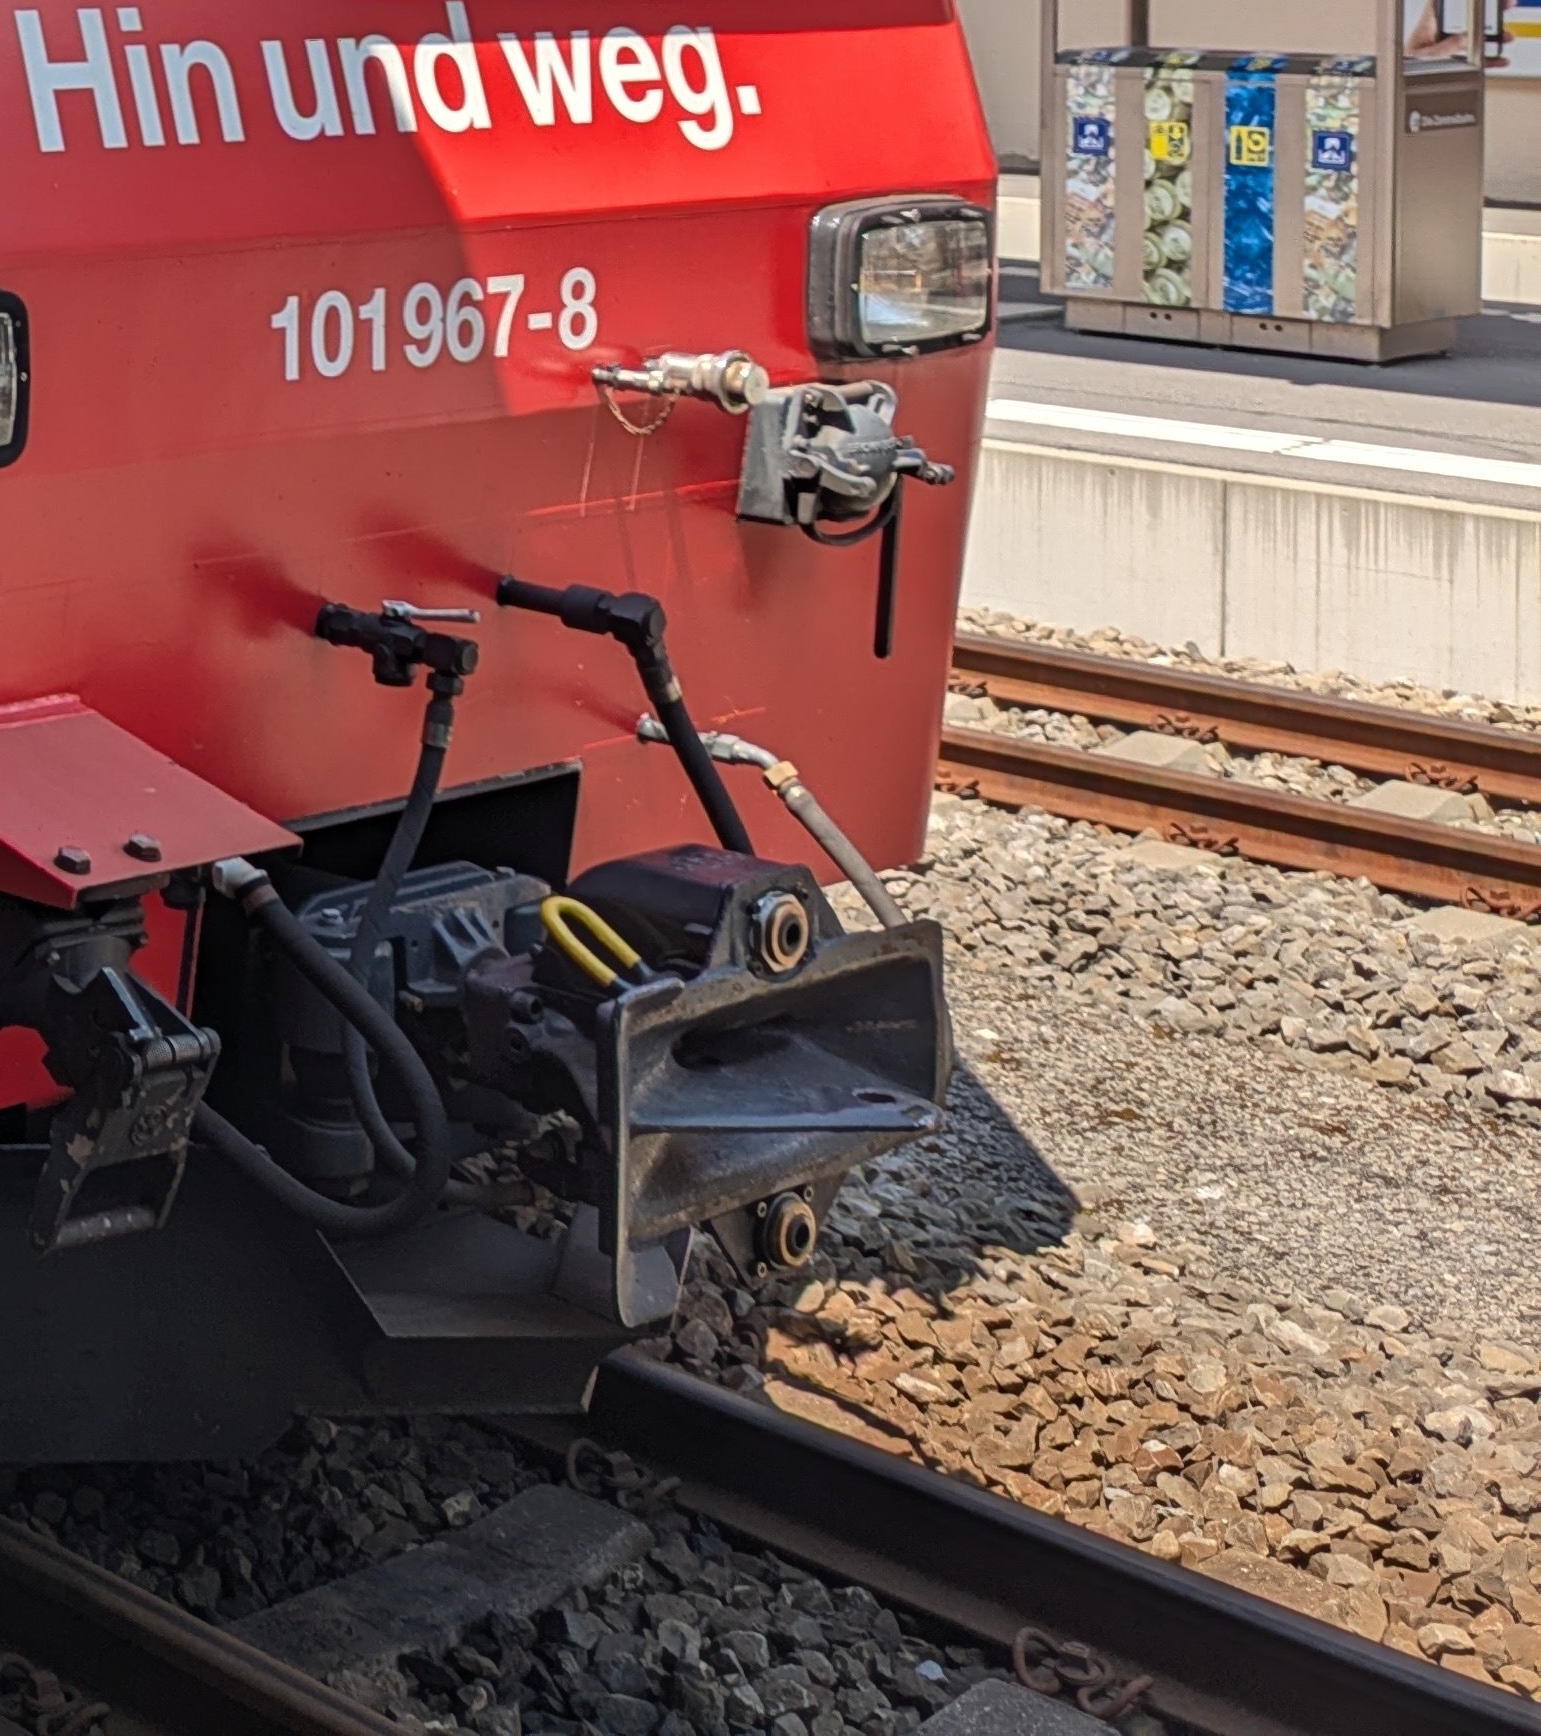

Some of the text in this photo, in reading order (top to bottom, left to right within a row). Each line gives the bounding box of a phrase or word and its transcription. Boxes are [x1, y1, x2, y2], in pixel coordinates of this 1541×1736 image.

[14, 0, 763, 154] Hin und weg.
